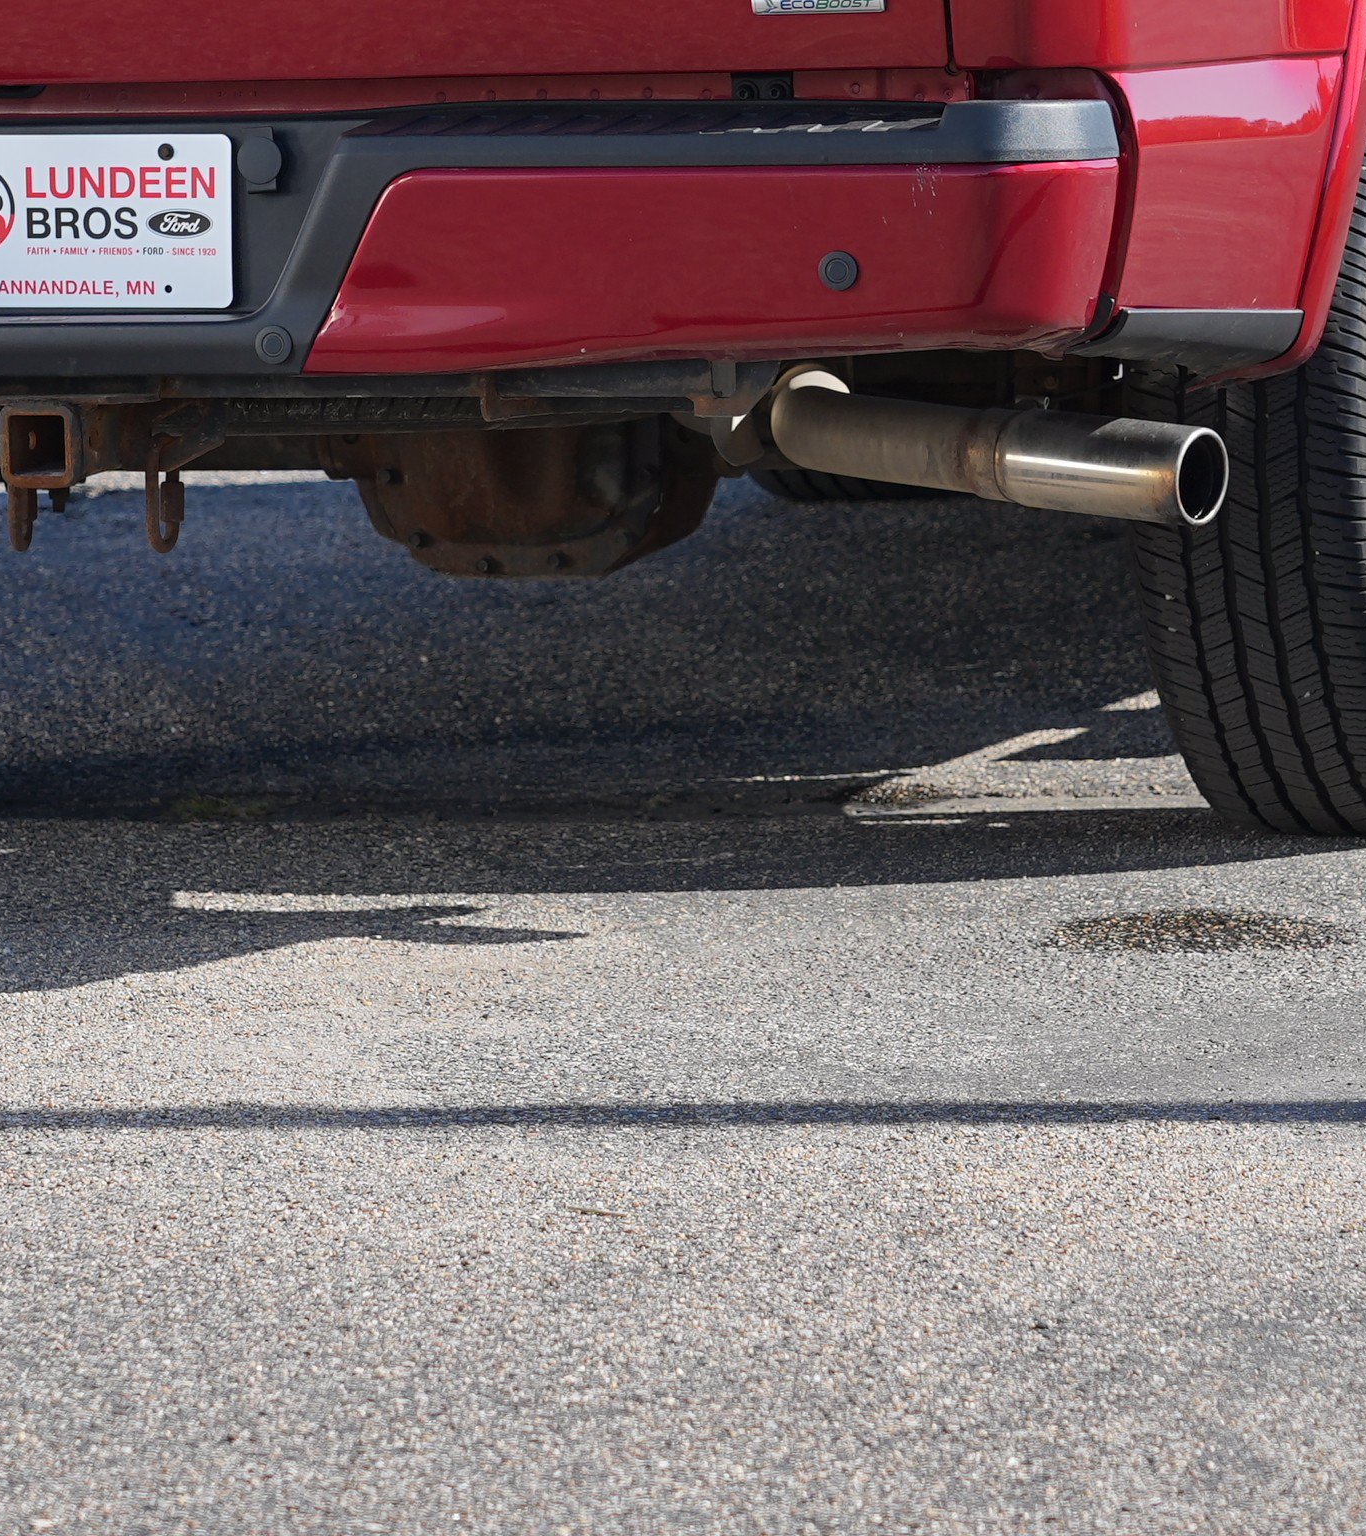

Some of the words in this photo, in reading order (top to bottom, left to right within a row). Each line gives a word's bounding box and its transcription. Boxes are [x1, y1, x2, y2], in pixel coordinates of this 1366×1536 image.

[25, 166, 216, 199] LUNDEEN
[26, 206, 139, 240] BROS
[159, 212, 201, 233] Ford
[26, 246, 51, 256] FAITH
[59, 246, 89, 256] FAMILY
[98, 247, 133, 256] FRIENDS
[142, 246, 164, 256] FORD
[171, 247, 196, 256] SINCE
[197, 247, 217, 257] 1920
[126, 279, 156, 295] MN
